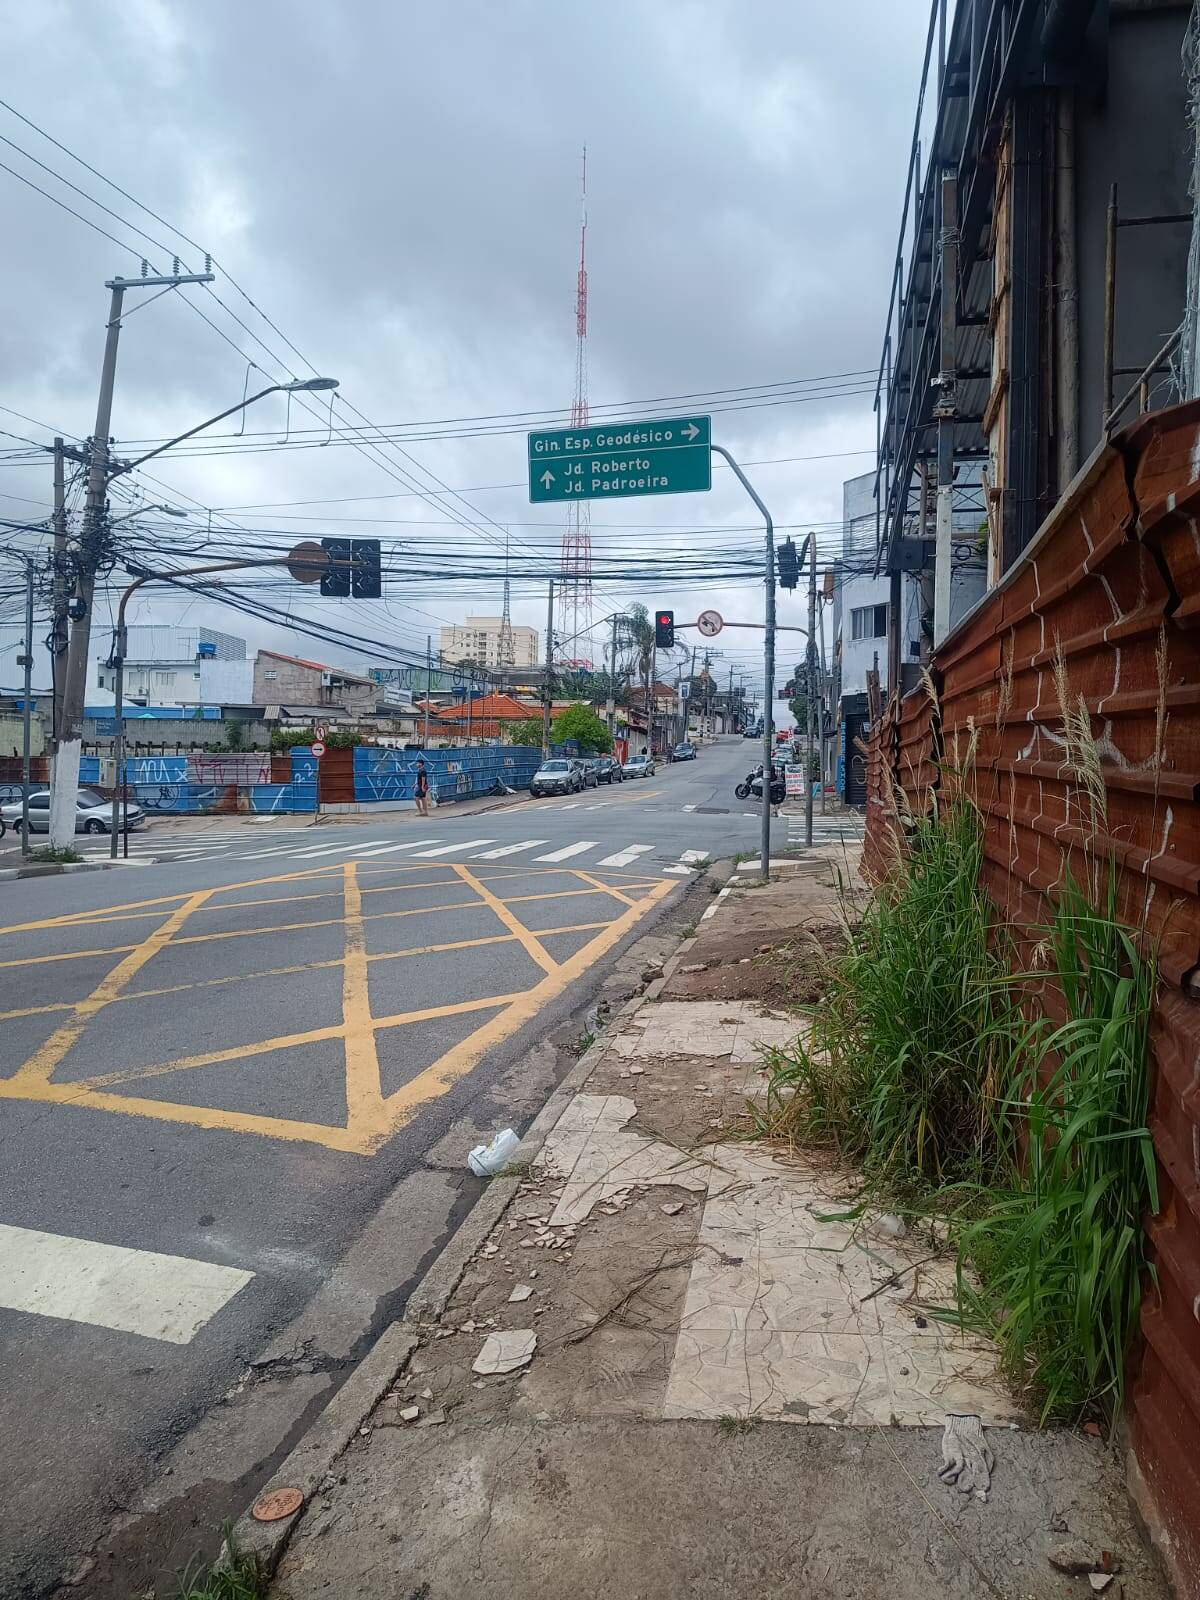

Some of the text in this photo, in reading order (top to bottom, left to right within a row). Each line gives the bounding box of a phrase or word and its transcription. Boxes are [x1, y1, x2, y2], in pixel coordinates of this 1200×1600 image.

[534, 429, 673, 452] Gin. Esp. Geodésico
[564, 458, 650, 476] Jd. Roberto
[564, 475, 669, 493] Jd. Padroeira
